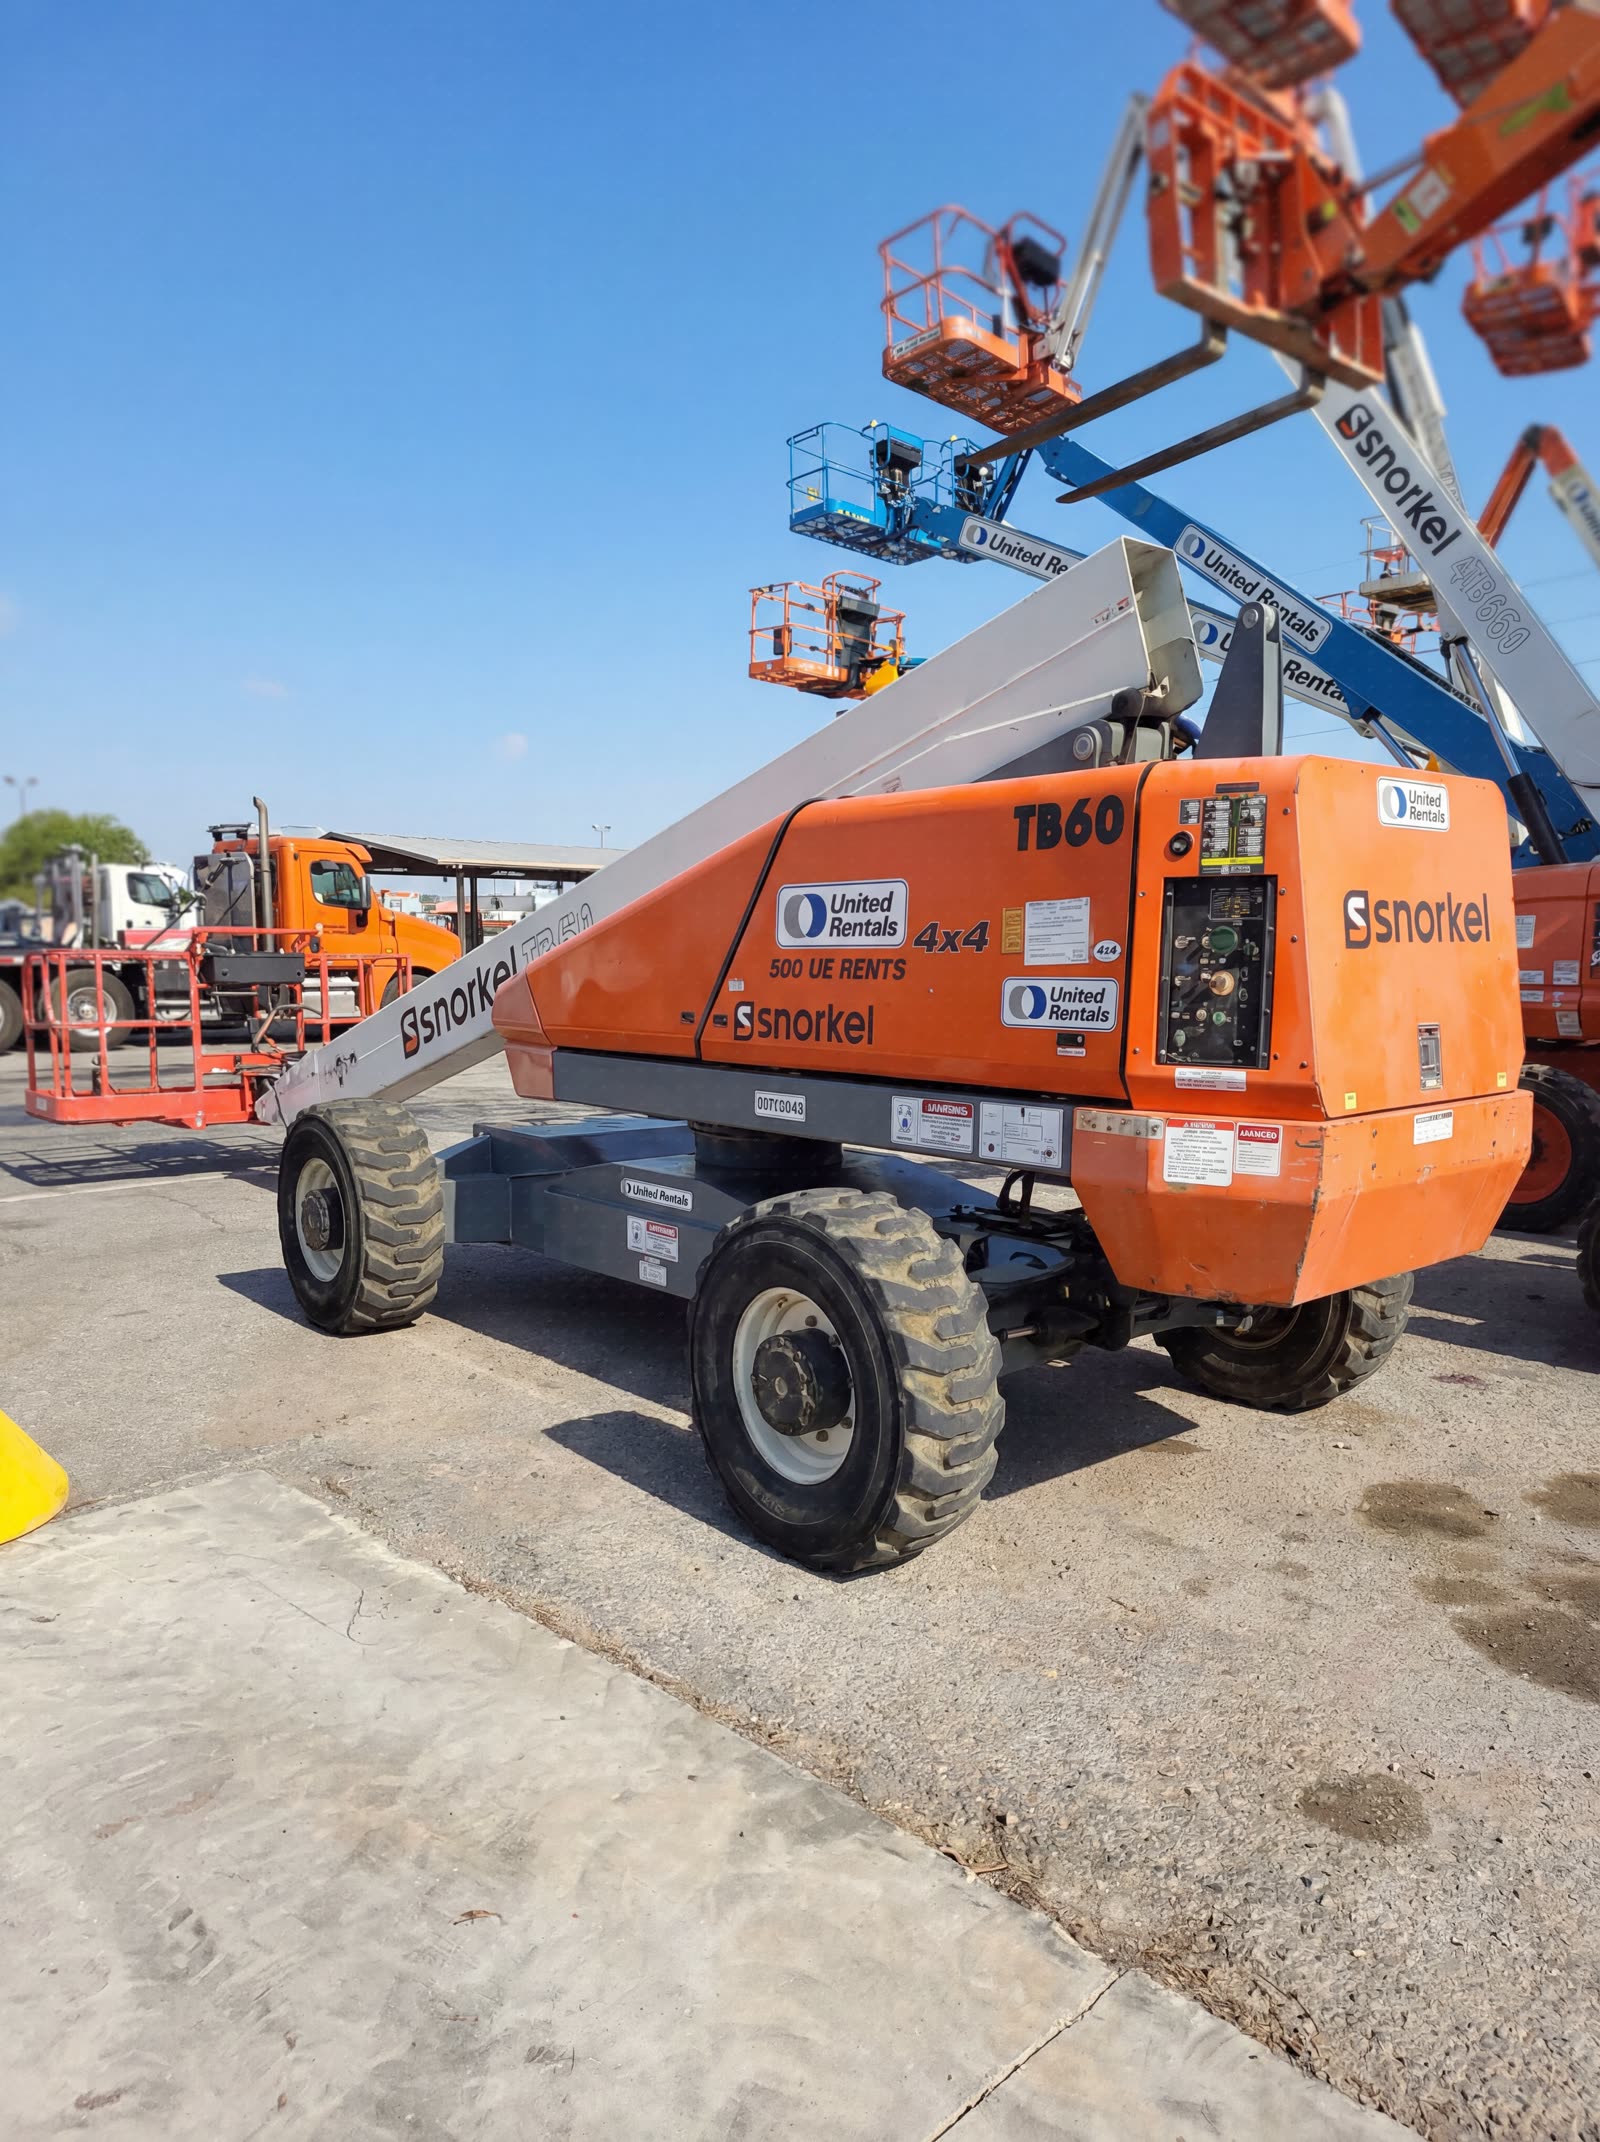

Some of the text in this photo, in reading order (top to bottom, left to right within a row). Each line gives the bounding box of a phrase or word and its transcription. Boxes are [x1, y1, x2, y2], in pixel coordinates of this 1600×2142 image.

[1355, 429, 1462, 557] snorkel
[989, 533, 1046, 567] United
[1204, 549, 1319, 643] United Rentals
[1283, 659, 1347, 703] Renta
[1409, 789, 1442, 808] United
[1013, 795, 1125, 851] TB60
[1409, 806, 1446, 825] Rentals
[830, 891, 894, 914] United
[1375, 891, 1491, 943] snorkel
[828, 914, 898, 938] Rentals
[913, 921, 990, 953] 4x4
[769, 958, 906, 980] 500 UE RENTS
[420, 945, 518, 1044] snorkel
[1049, 986, 1106, 1004] United
[757, 1004, 874, 1045] snorkel
[1048, 1004, 1110, 1024] Rentals
[632, 1183, 689, 1207] United Rentals
